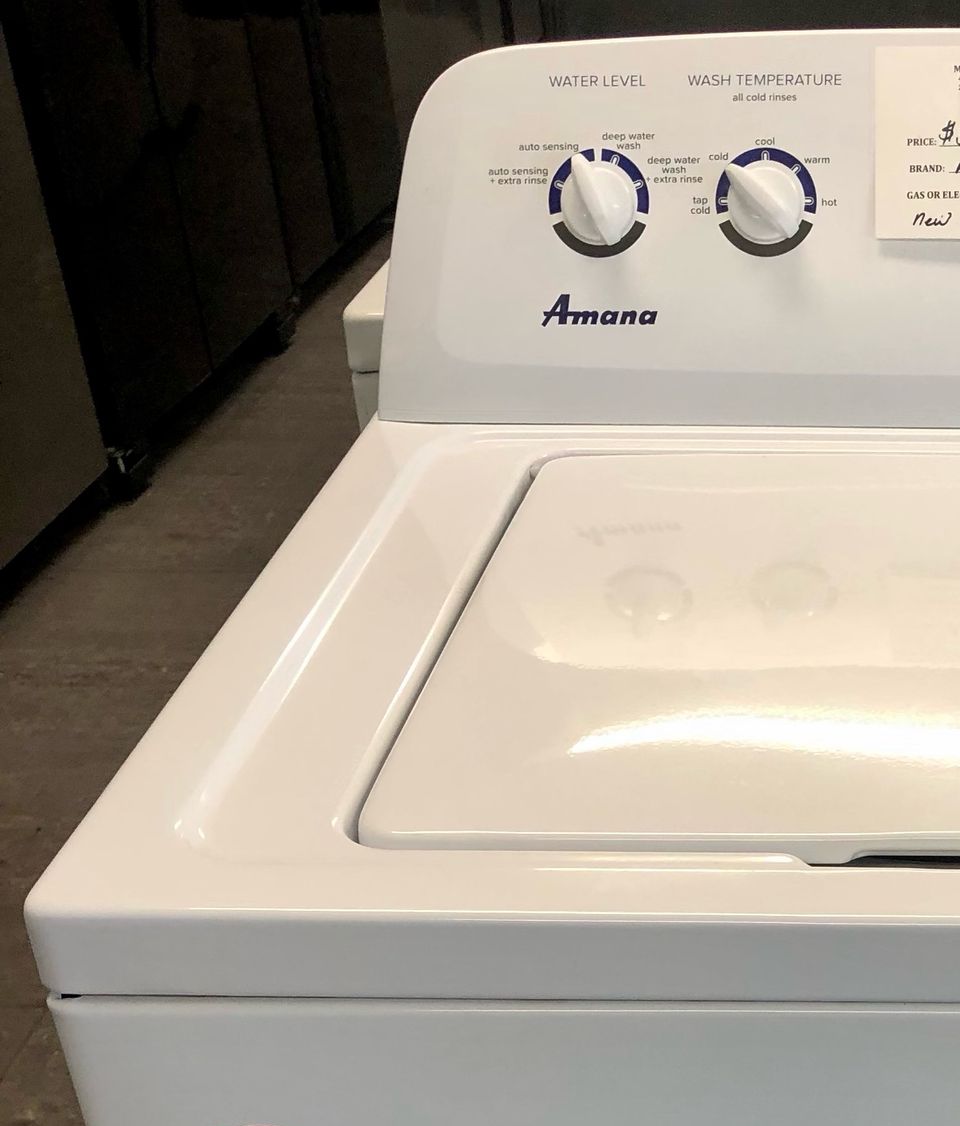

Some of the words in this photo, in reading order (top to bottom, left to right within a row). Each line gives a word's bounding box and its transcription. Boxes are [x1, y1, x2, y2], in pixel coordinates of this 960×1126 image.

[549, 75, 598, 87] WATER
[602, 75, 646, 87] LEVEL
[688, 74, 732, 86] WASH
[736, 74, 842, 86] TEMPERATURE
[732, 93, 743, 101] all
[746, 93, 766, 101] cold
[768, 93, 797, 101] rinses
[602, 133, 625, 142] deep
[755, 137, 775, 145] cool
[519, 142, 540, 150] auto
[543, 142, 579, 152] sensing
[616, 142, 641, 150] wash
[907, 138, 937, 147] PRICE:
[647, 156, 669, 166] deep
[673, 156, 700, 164] water
[709, 152, 729, 161] cold
[804, 156, 830, 164] warm
[488, 167, 509, 175] auto
[512, 167, 548, 177] sensing
[909, 165, 945, 173] BRAND:
[907, 191, 925, 200] GAS
[927, 191, 941, 199] OR
[693, 197, 708, 207] tap
[822, 198, 837, 207] hot
[691, 206, 710, 214] cold
[541, 294, 657, 327] Amana
